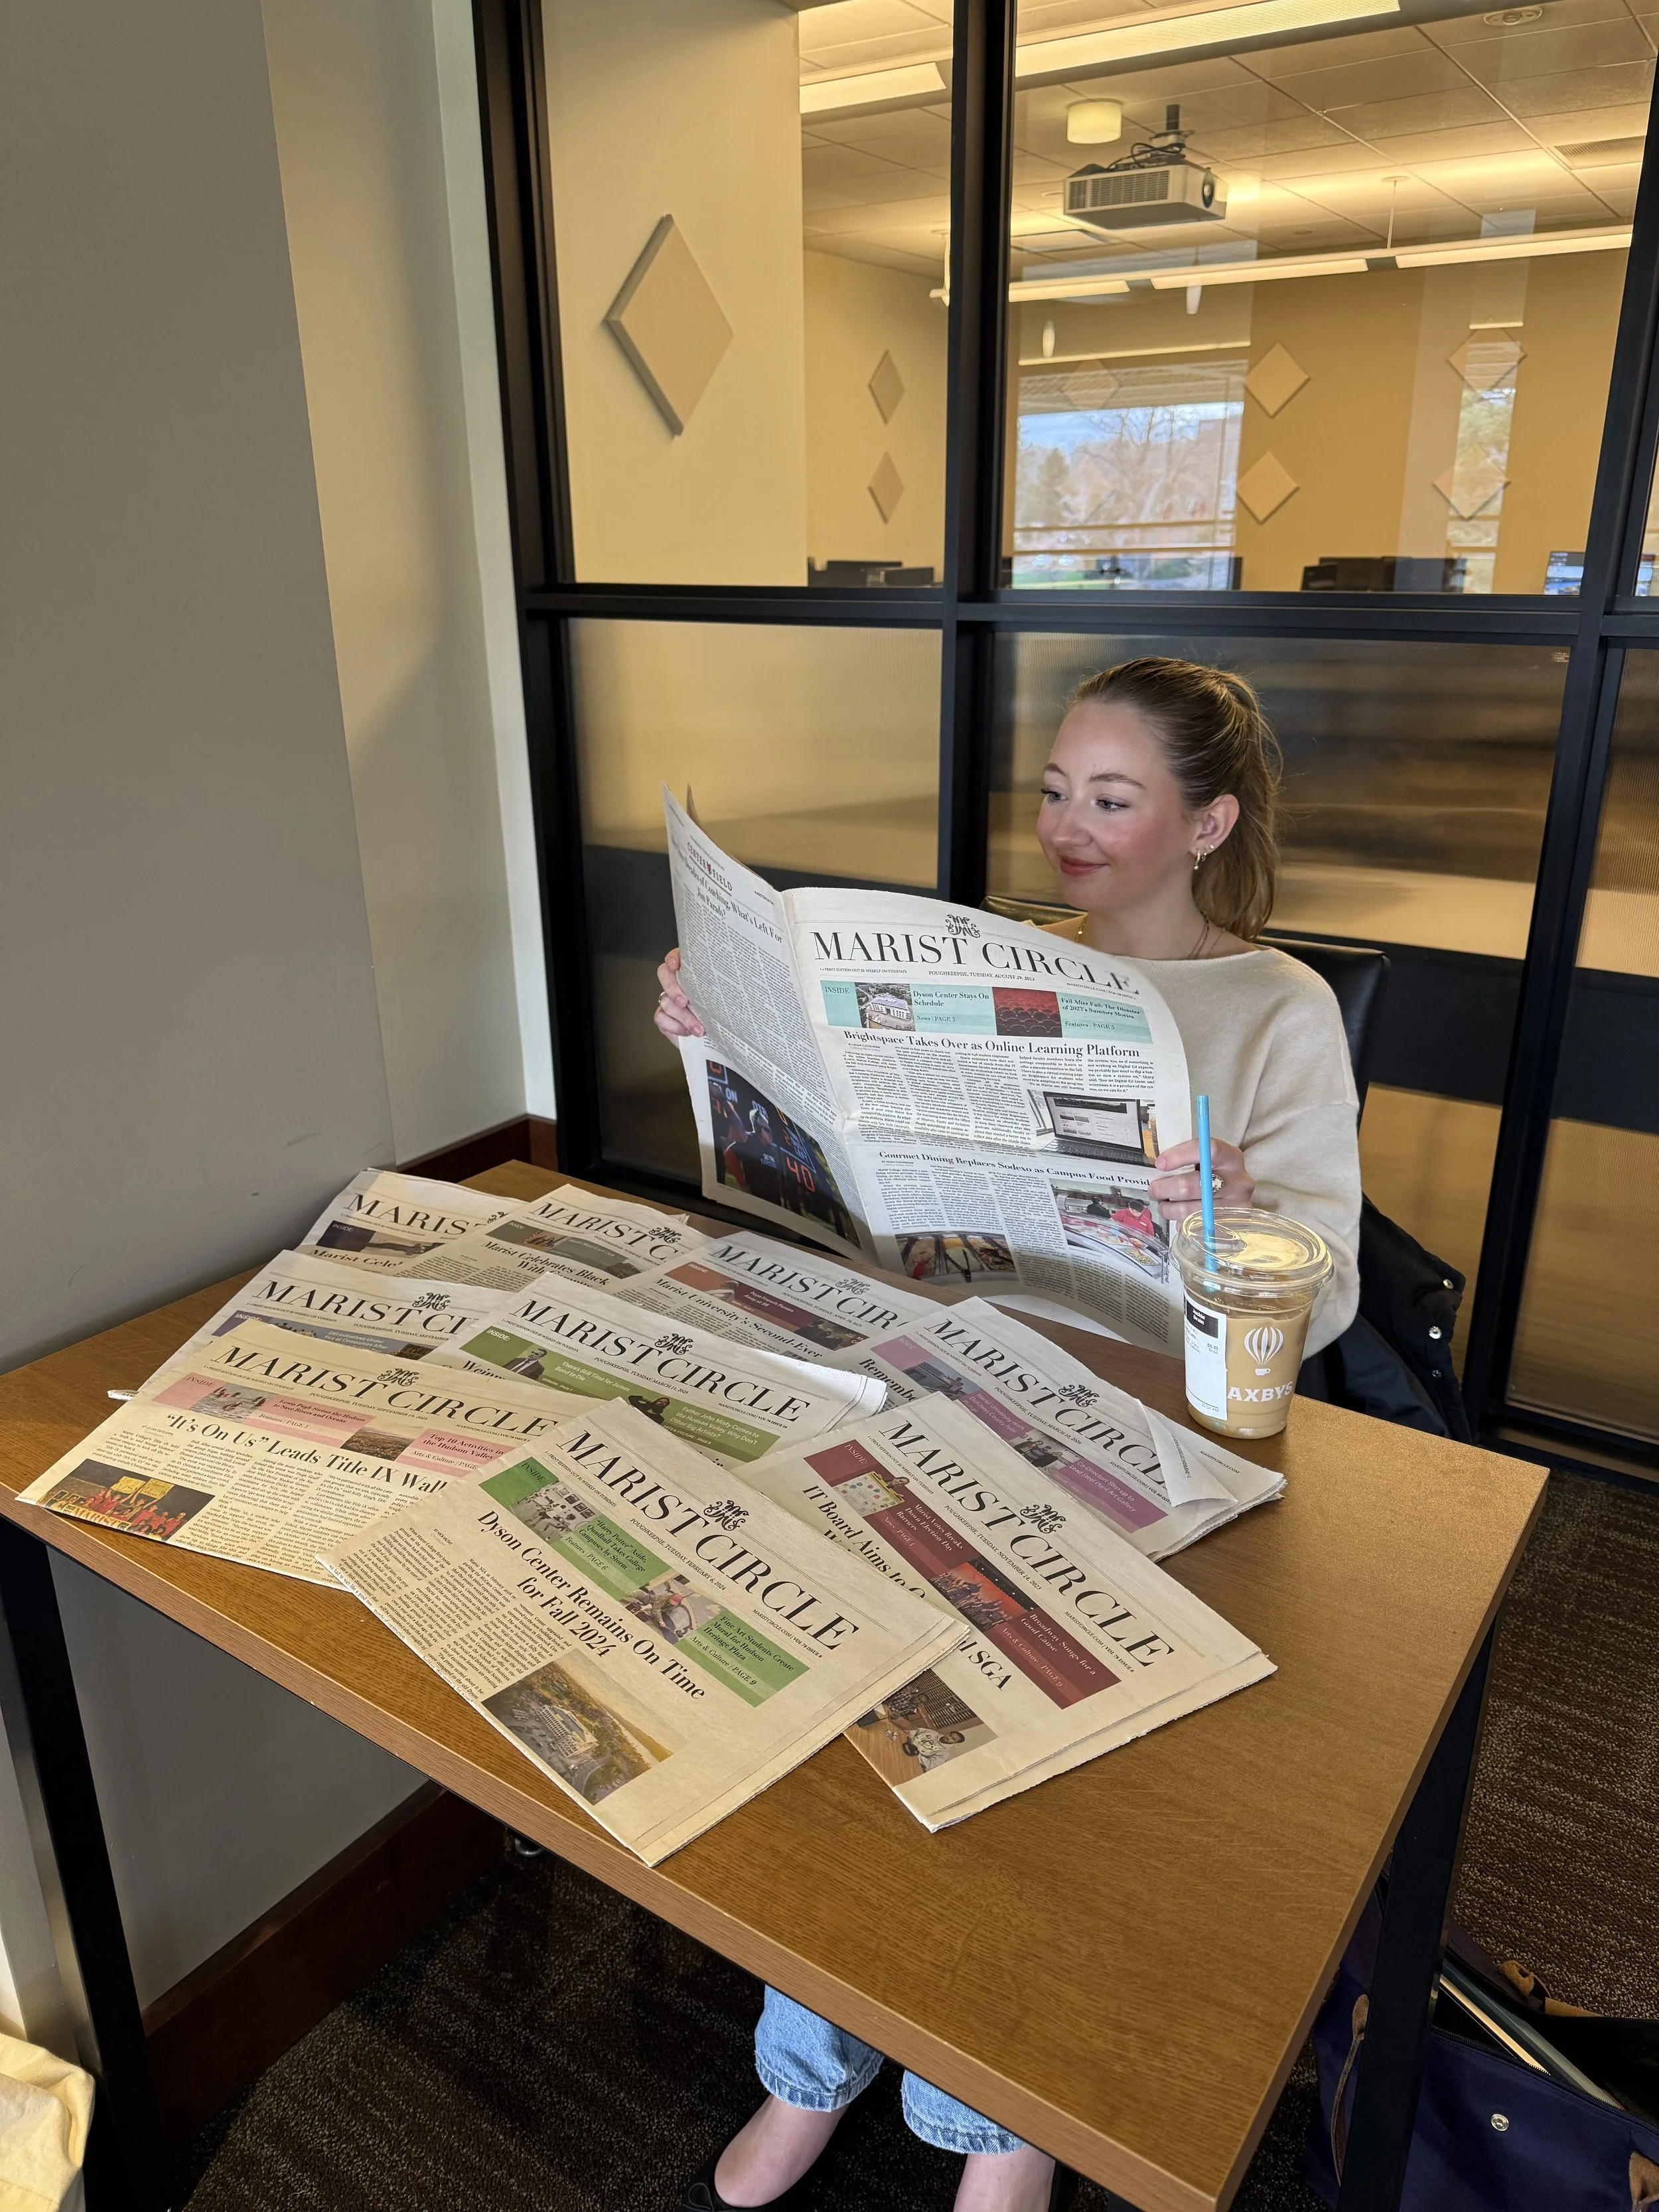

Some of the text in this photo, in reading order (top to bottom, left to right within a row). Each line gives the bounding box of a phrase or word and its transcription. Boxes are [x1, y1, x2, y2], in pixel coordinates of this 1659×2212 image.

[711, 869, 733, 891] FIELD
[705, 896, 726, 921] Parady?
[731, 901, 753, 924] What's
[754, 917, 768, 937] Left
[810, 931, 1140, 995] MARIST CIRCLE
[913, 990, 934, 999] Dyson
[844, 1030, 904, 1045] Brightspace
[906, 1035, 938, 1047] Takes
[942, 1038, 968, 1050] Over
[985, 1041, 1025, 1053] Online
[1029, 1043, 1083, 1057] Learning
[1086, 1044, 1140, 1057] Platform
[786, 1155, 816, 1193] 40
[879, 1151, 919, 1163] Gourmet
[921, 1153, 954, 1165] Dining
[955, 1156, 995, 1169] Replaces
[997, 1161, 1033, 1173] Sodexo
[1046, 1167, 1087, 1181] Campus
[1089, 1172, 1115, 1183] Food
[344, 1193, 469, 1235] MARIS
[529, 1202, 656, 1247] MARIST
[481, 1241, 518, 1258] Marist
[518, 1251, 576, 1276] Celebrates
[576, 1269, 611, 1287] Black
[517, 1260, 546, 1276] With
[251, 1279, 423, 1327] MARIST
[708, 1244, 841, 1307] MARIST
[835, 1295, 910, 1331] CIR
[486, 1328, 510, 1342] INSIDE:
[653, 1278, 690, 1297] Marist
[687, 1293, 751, 1329] University's
[749, 1323, 824, 1359] Second-Ever
[508, 1299, 811, 1424] MARIST CIRCLE
[555, 1366, 570, 1376] Bond
[562, 1361, 630, 1392] There's Still Time for James
[858, 1359, 918, 1403] Remembe
[210, 1345, 558, 1437] MARIST CIRCLE
[924, 1318, 1067, 1409] MARIST
[1054, 1409, 1167, 1492] CIRCL
[1227, 1381, 1293, 1402] AXBYS
[670, 1418, 687, 1427] Other
[696, 1426, 721, 1438] Artists?
[682, 1406, 700, 1417] Father
[700, 1413, 715, 1422] John
[716, 1418, 732, 1428] Misty
[732, 1425, 751, 1436] Comes
[686, 1416, 707, 1427] Hudson
[709, 1422, 727, 1434] Valley,
[727, 1430, 741, 1439] Why
[741, 1436, 758, 1445] Don't
[201, 1424, 230, 1440] On
[265, 1441, 321, 1465] Leads
[325, 1454, 368, 1477] Title
[370, 1466, 399, 1483] IX
[431, 1434, 445, 1442] Top
[457, 1440, 494, 1453] Activities
[437, 1442, 468, 1454] Hudson
[470, 1450, 496, 1461] Valley
[555, 1430, 859, 1651] MARIST CIRCLE
[802, 1485, 828, 1501] IT
[818, 1501, 864, 1540] Board
[853, 1539, 891, 1574] Aims
[897, 1511, 917, 1532] Barriers
[905, 1508, 953, 1552] Down Election Day
[915, 1504, 963, 1549] Marist Votes Breaks
[579, 1529, 604, 1550] Campuses
[610, 1554, 628, 1570] Storm
[587, 1524, 646, 1572] Quadball Takes College
[630, 1518, 664, 1546] POUGHKEEPSIE,
[665, 1544, 687, 1562] TUESDAY,
[686, 1560, 711, 1580] FEBRUARY
[715, 1580, 727, 1591] 2024
[632, 1548, 646, 1563] Aside,
[879, 1420, 1175, 1667] MARIST CIRCLE
[476, 1510, 705, 1700] Dyson Center Remains On Time
[516, 1576, 617, 1659] for Fall 2024
[703, 1627, 746, 1660] Heritage Plaza
[711, 1621, 764, 1662] Mural for Hudson
[721, 1616, 794, 1672] Fine Art Students Create
[1021, 1618, 1057, 1652] Good Cause
[1030, 1613, 1059, 1642] Broadway
[1060, 1641, 1078, 1660] Songs
[1080, 1660, 1092, 1670] for
[968, 1651, 1013, 1691] SGA
